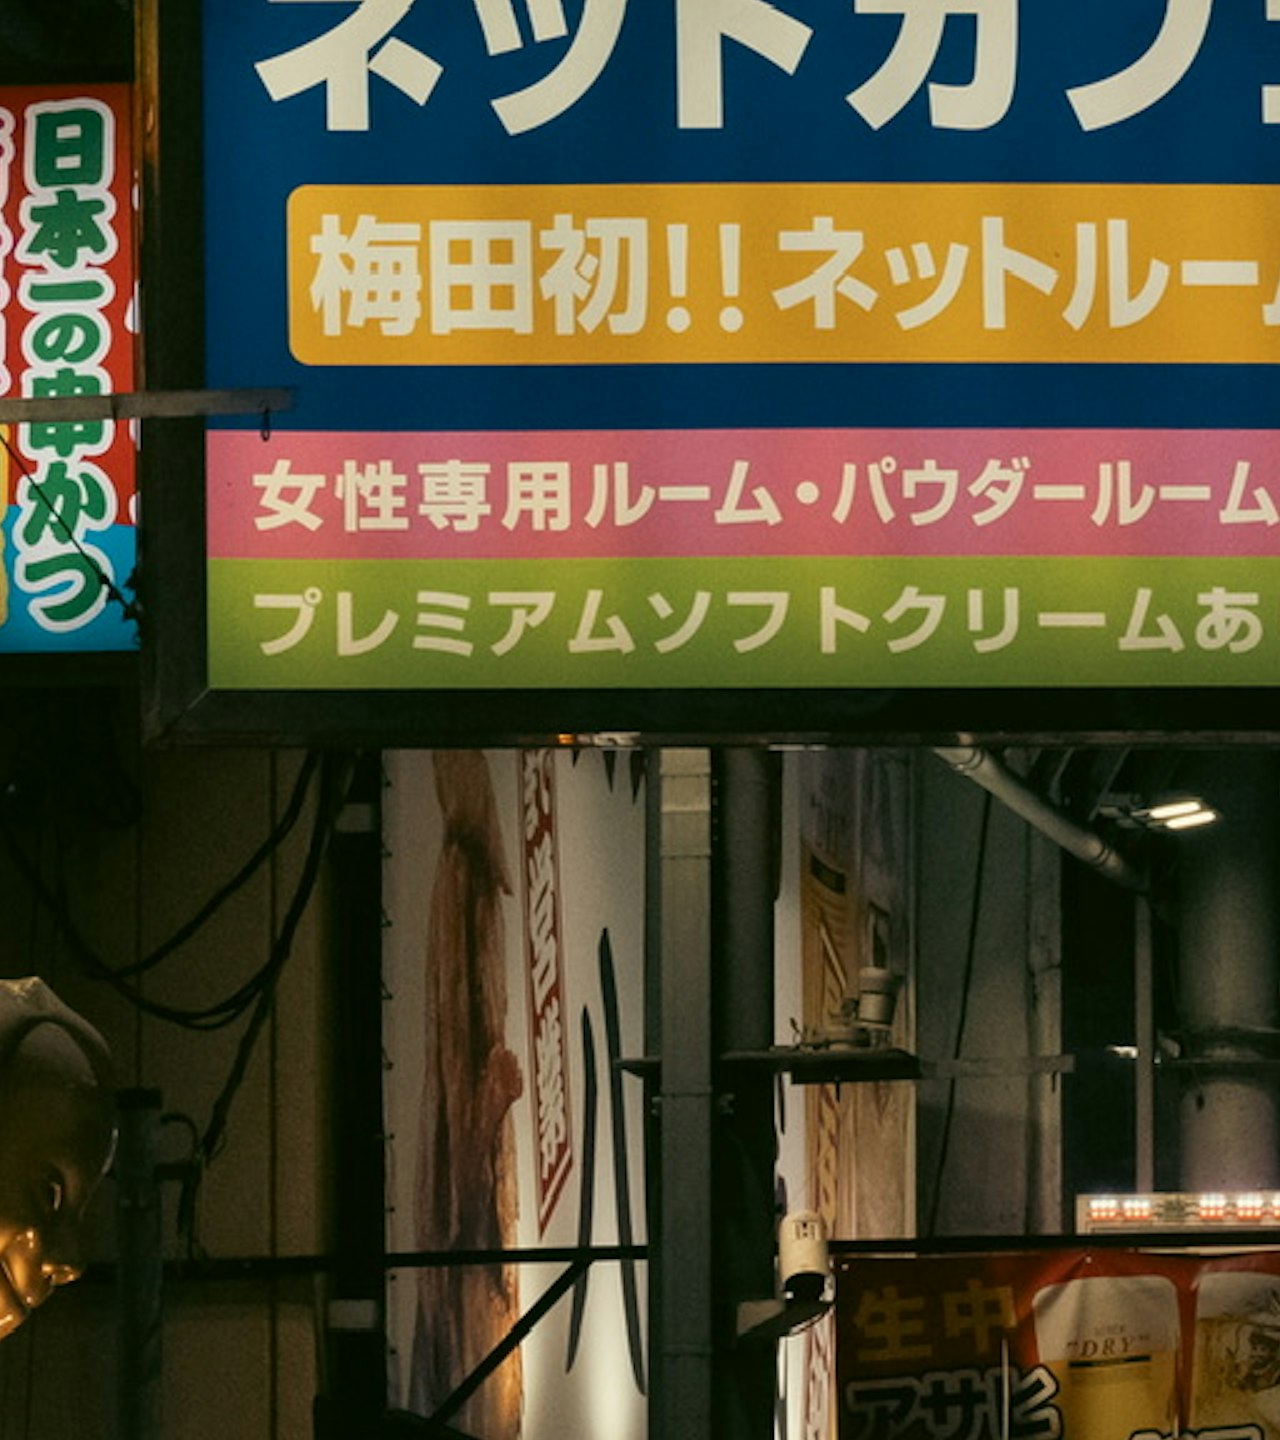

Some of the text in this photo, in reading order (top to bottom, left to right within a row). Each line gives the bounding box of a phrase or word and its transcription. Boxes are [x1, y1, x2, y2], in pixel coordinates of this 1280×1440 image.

[18, 99, 118, 634] 日本一の串かつ
[852, 1278, 1017, 1364] 生中
